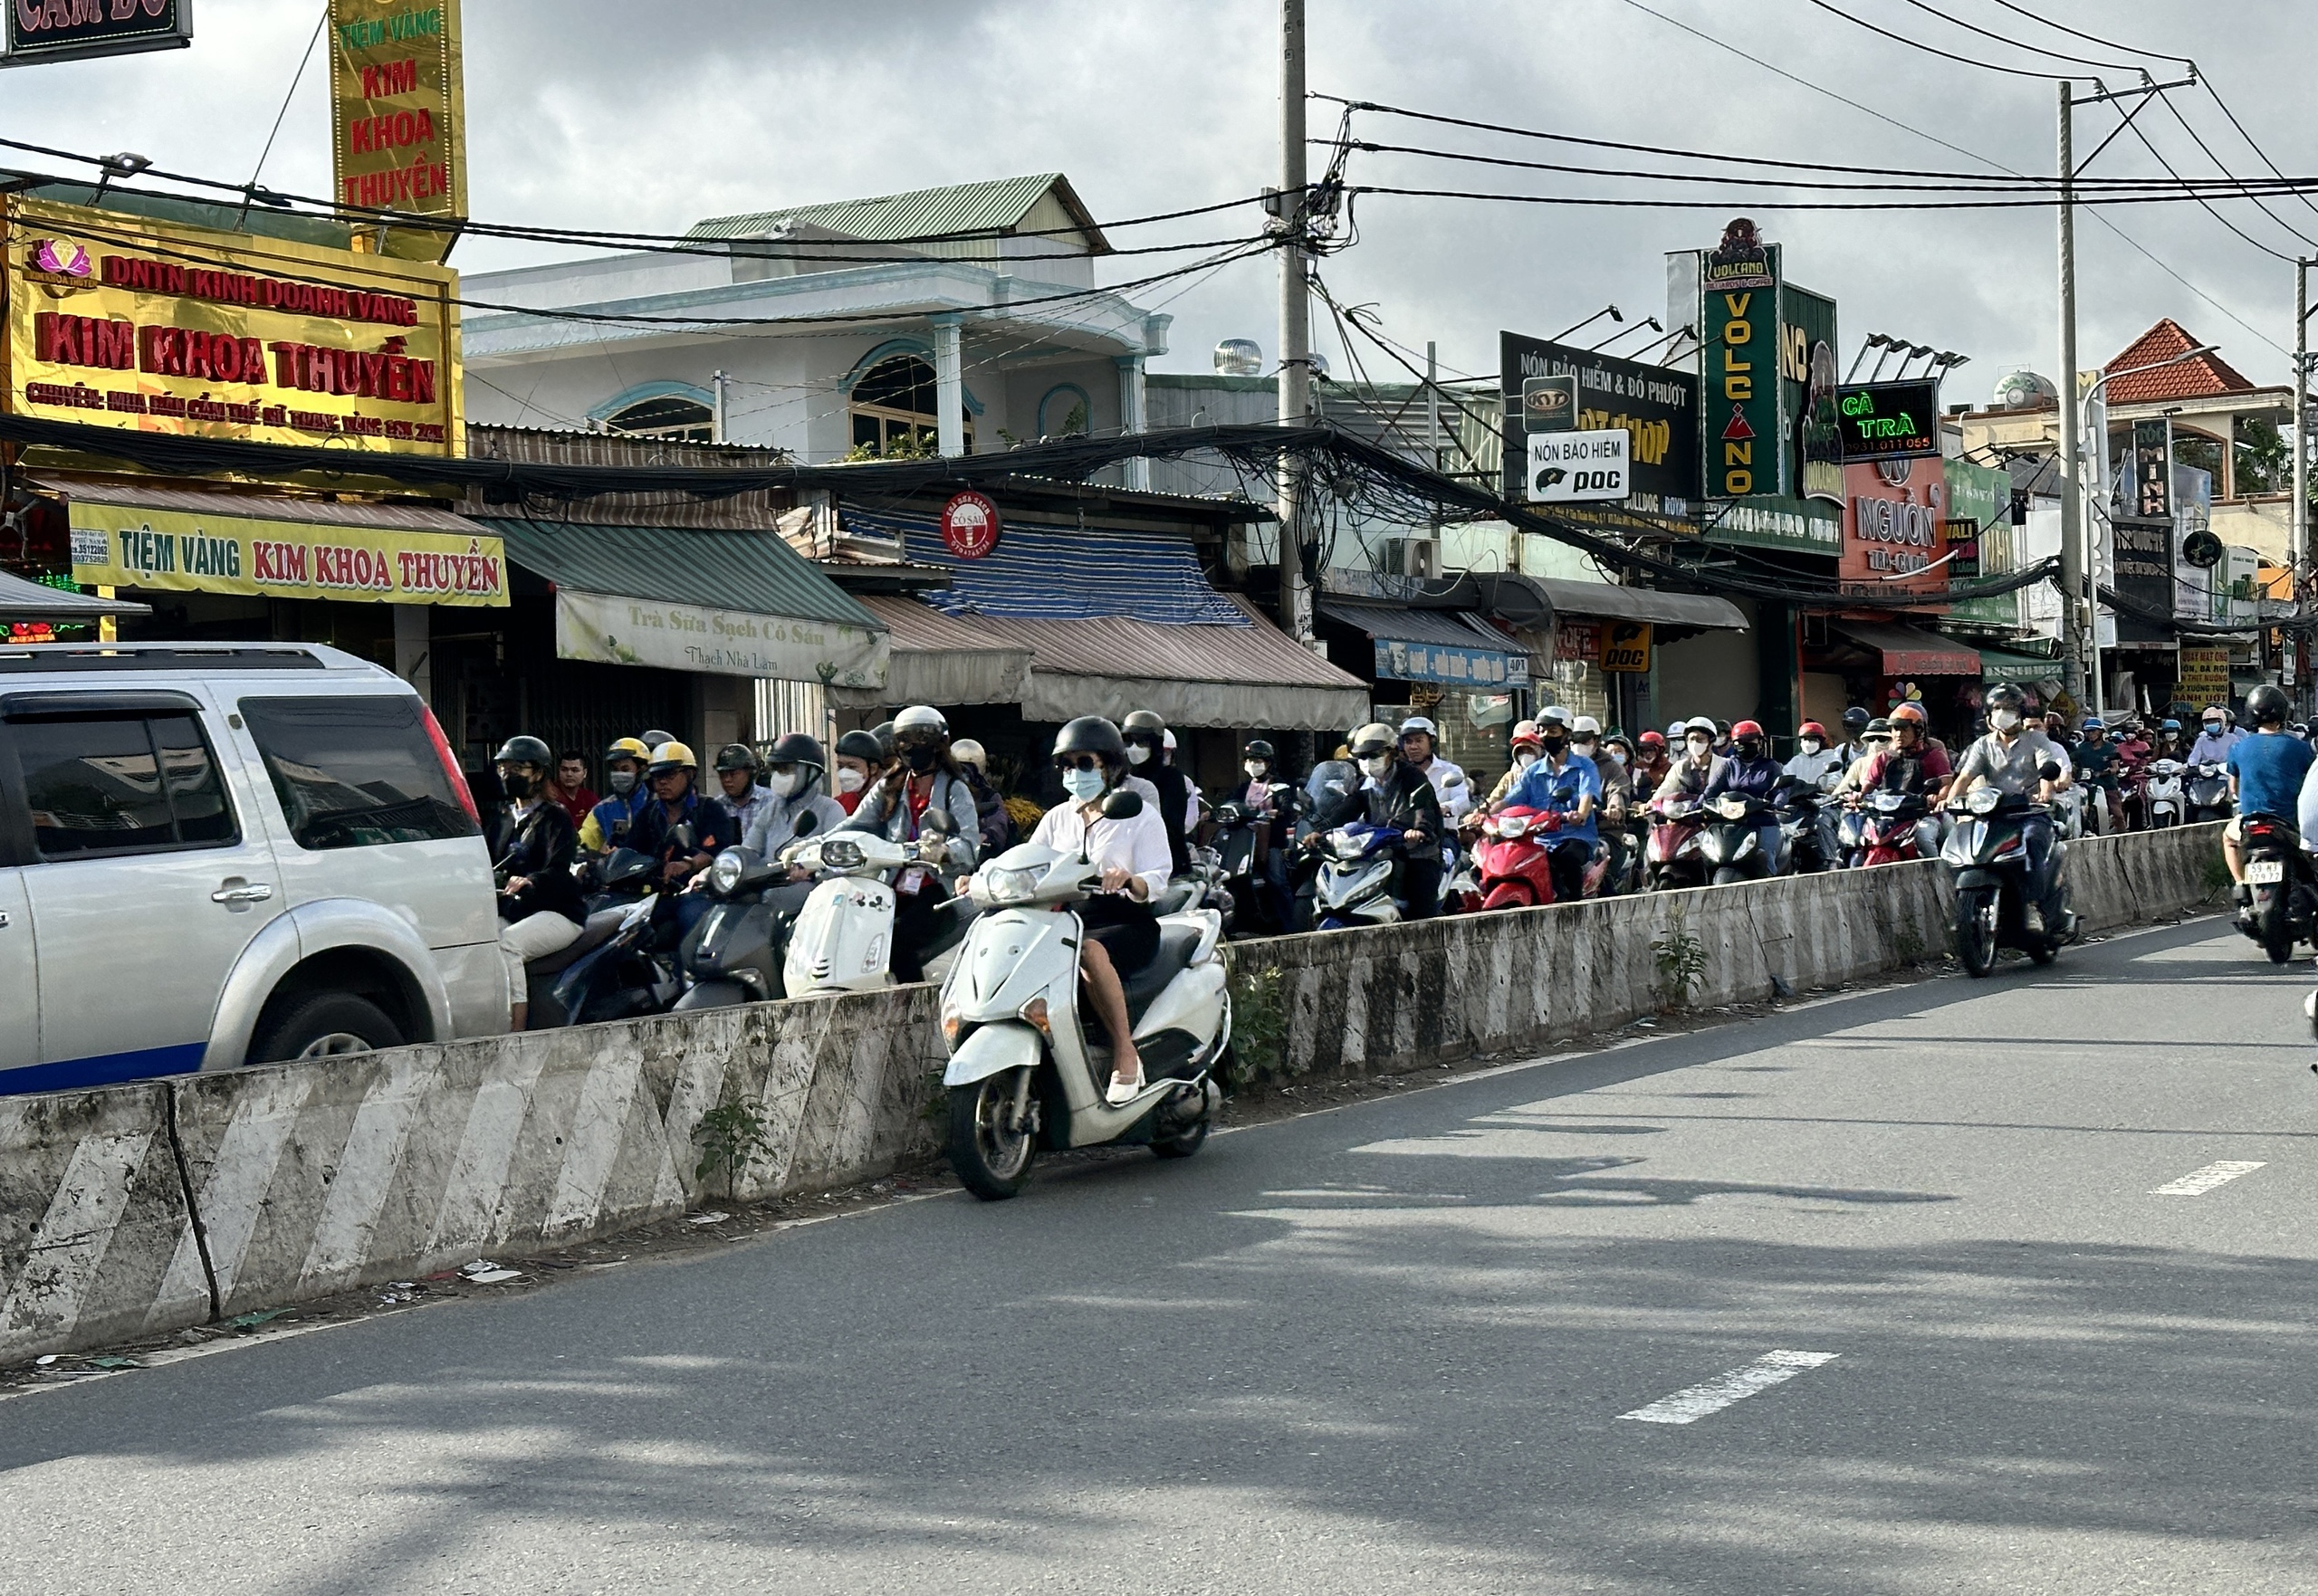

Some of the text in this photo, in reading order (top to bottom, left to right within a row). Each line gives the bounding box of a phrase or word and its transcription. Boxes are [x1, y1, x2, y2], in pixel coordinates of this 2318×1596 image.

[390, 7, 441, 42] VÀNG
[362, 58, 417, 100] KIM
[350, 108, 435, 155] KHOA
[344, 150, 446, 206] THUYỀN
[101, 256, 187, 293] DNTN
[186, 269, 256, 303] KINH
[256, 278, 350, 316] DOANH
[1713, 262, 1764, 278] VOLCANO
[34, 312, 436, 404] KIM KHOA THUYỀN
[1520, 350, 1547, 377] NÓN
[1582, 360, 1612, 393] HIỂM
[1614, 374, 1624, 395] &
[1628, 371, 1644, 399] ĐỒ
[1648, 380, 1687, 411] PHƯỢT
[1843, 392, 1874, 416] CÀ
[1857, 412, 1917, 438] TRÀ
[1534, 440, 1559, 462] NÓN
[119, 524, 498, 591] TIỆM VÀNG KIM KHOA THUYỀN
[628, 606, 664, 629] Trà
[668, 611, 706, 633] Sữa
[712, 616, 758, 642] Sạch
[762, 621, 787, 642] Cô
[684, 645, 778, 672] Thạch Nhà Làm
